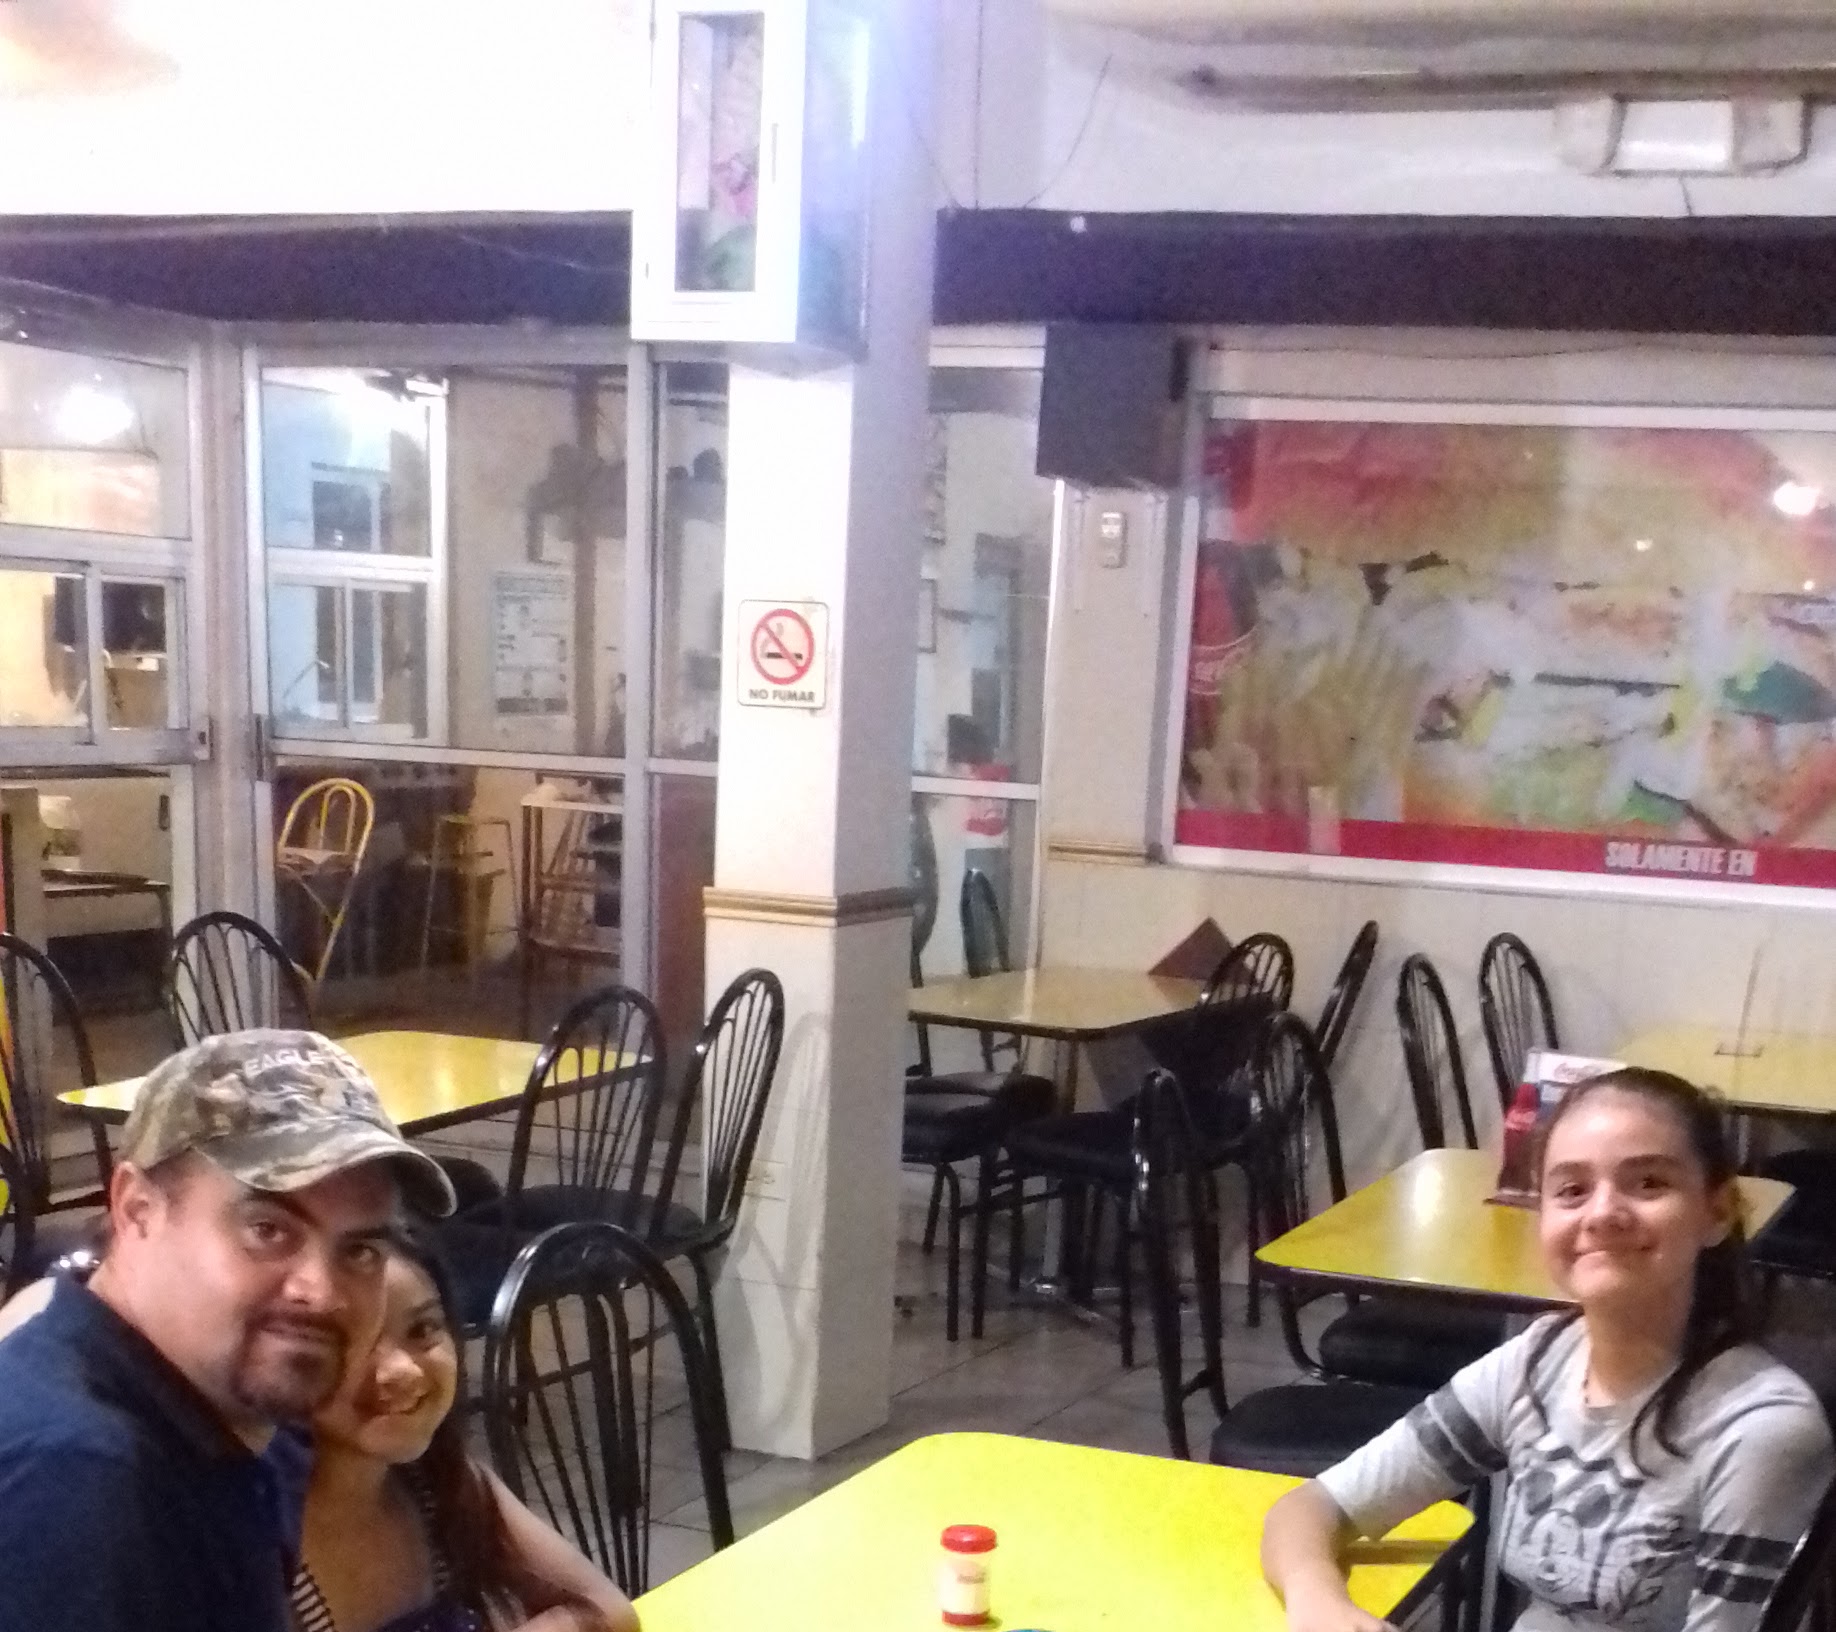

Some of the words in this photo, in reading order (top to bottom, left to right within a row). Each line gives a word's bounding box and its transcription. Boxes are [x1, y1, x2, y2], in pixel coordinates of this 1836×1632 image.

[749, 688, 769, 700] NO
[772, 690, 815, 702] FUMAR
[1605, 841, 1726, 874] SOLAMENTE
[1727, 849, 1758, 876] EN
[243, 1048, 325, 1079] EAGLE
